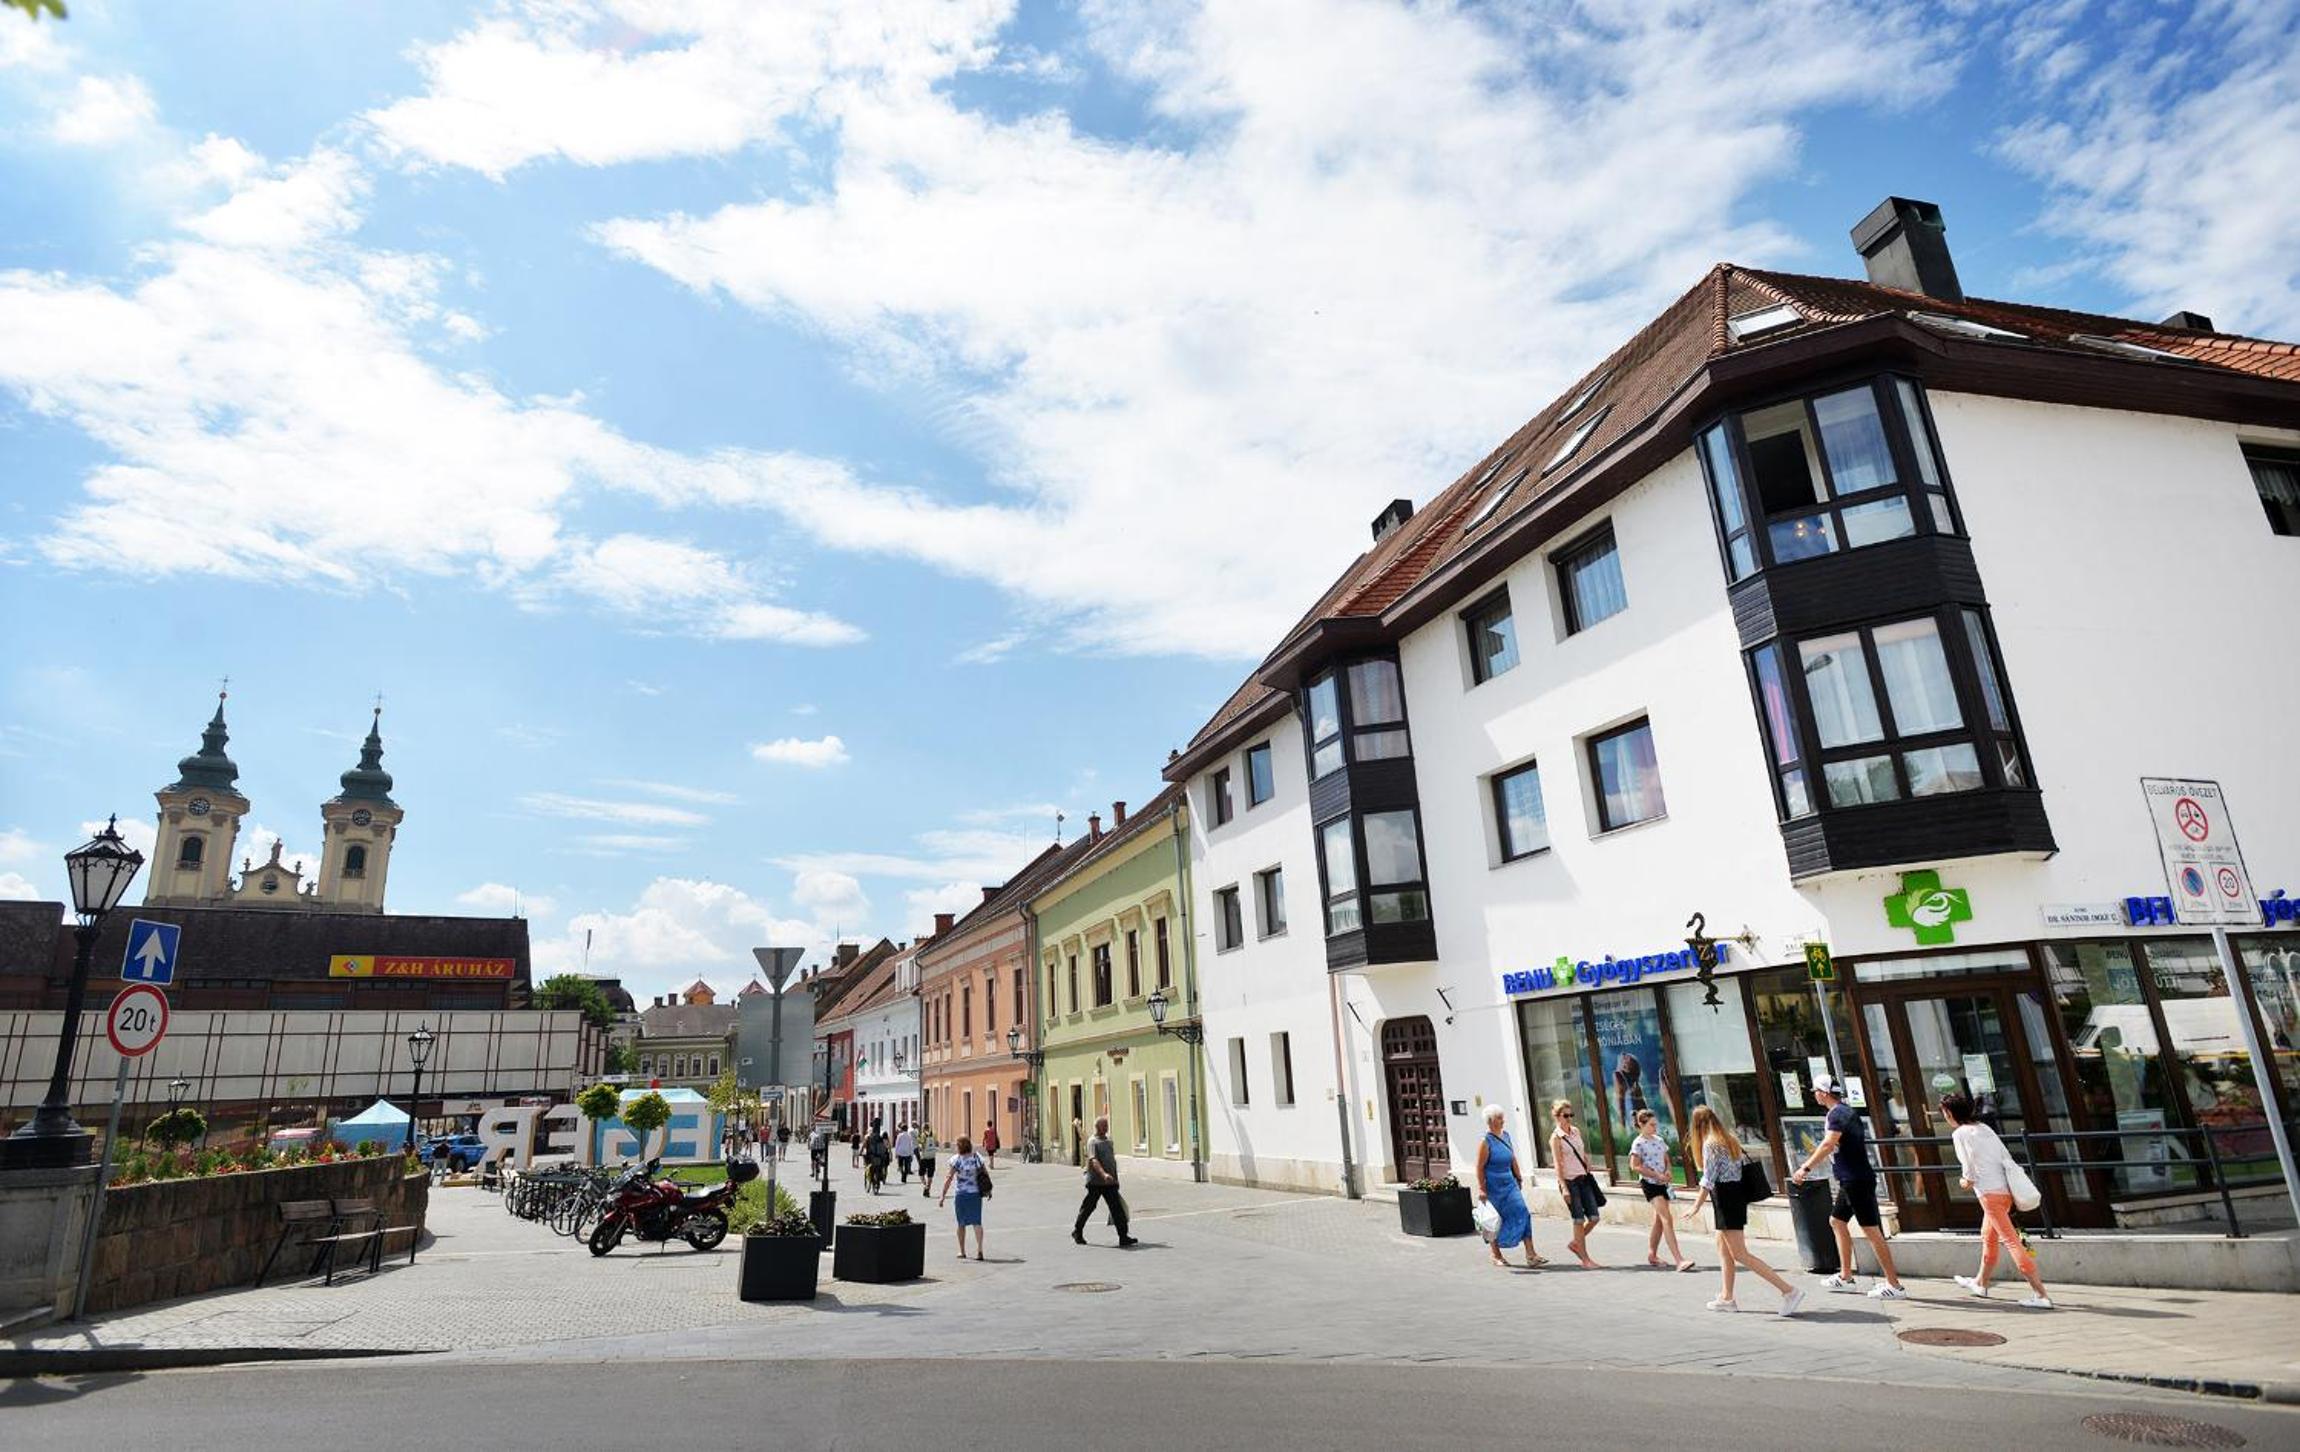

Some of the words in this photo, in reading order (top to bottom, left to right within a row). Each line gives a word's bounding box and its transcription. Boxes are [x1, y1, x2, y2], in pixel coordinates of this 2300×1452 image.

[384, 961, 424, 976] Z&H
[430, 959, 506, 976] ÁRUHÁZ
[1503, 967, 1554, 994] BENU
[1576, 944, 1728, 988] Gyógyszertr
